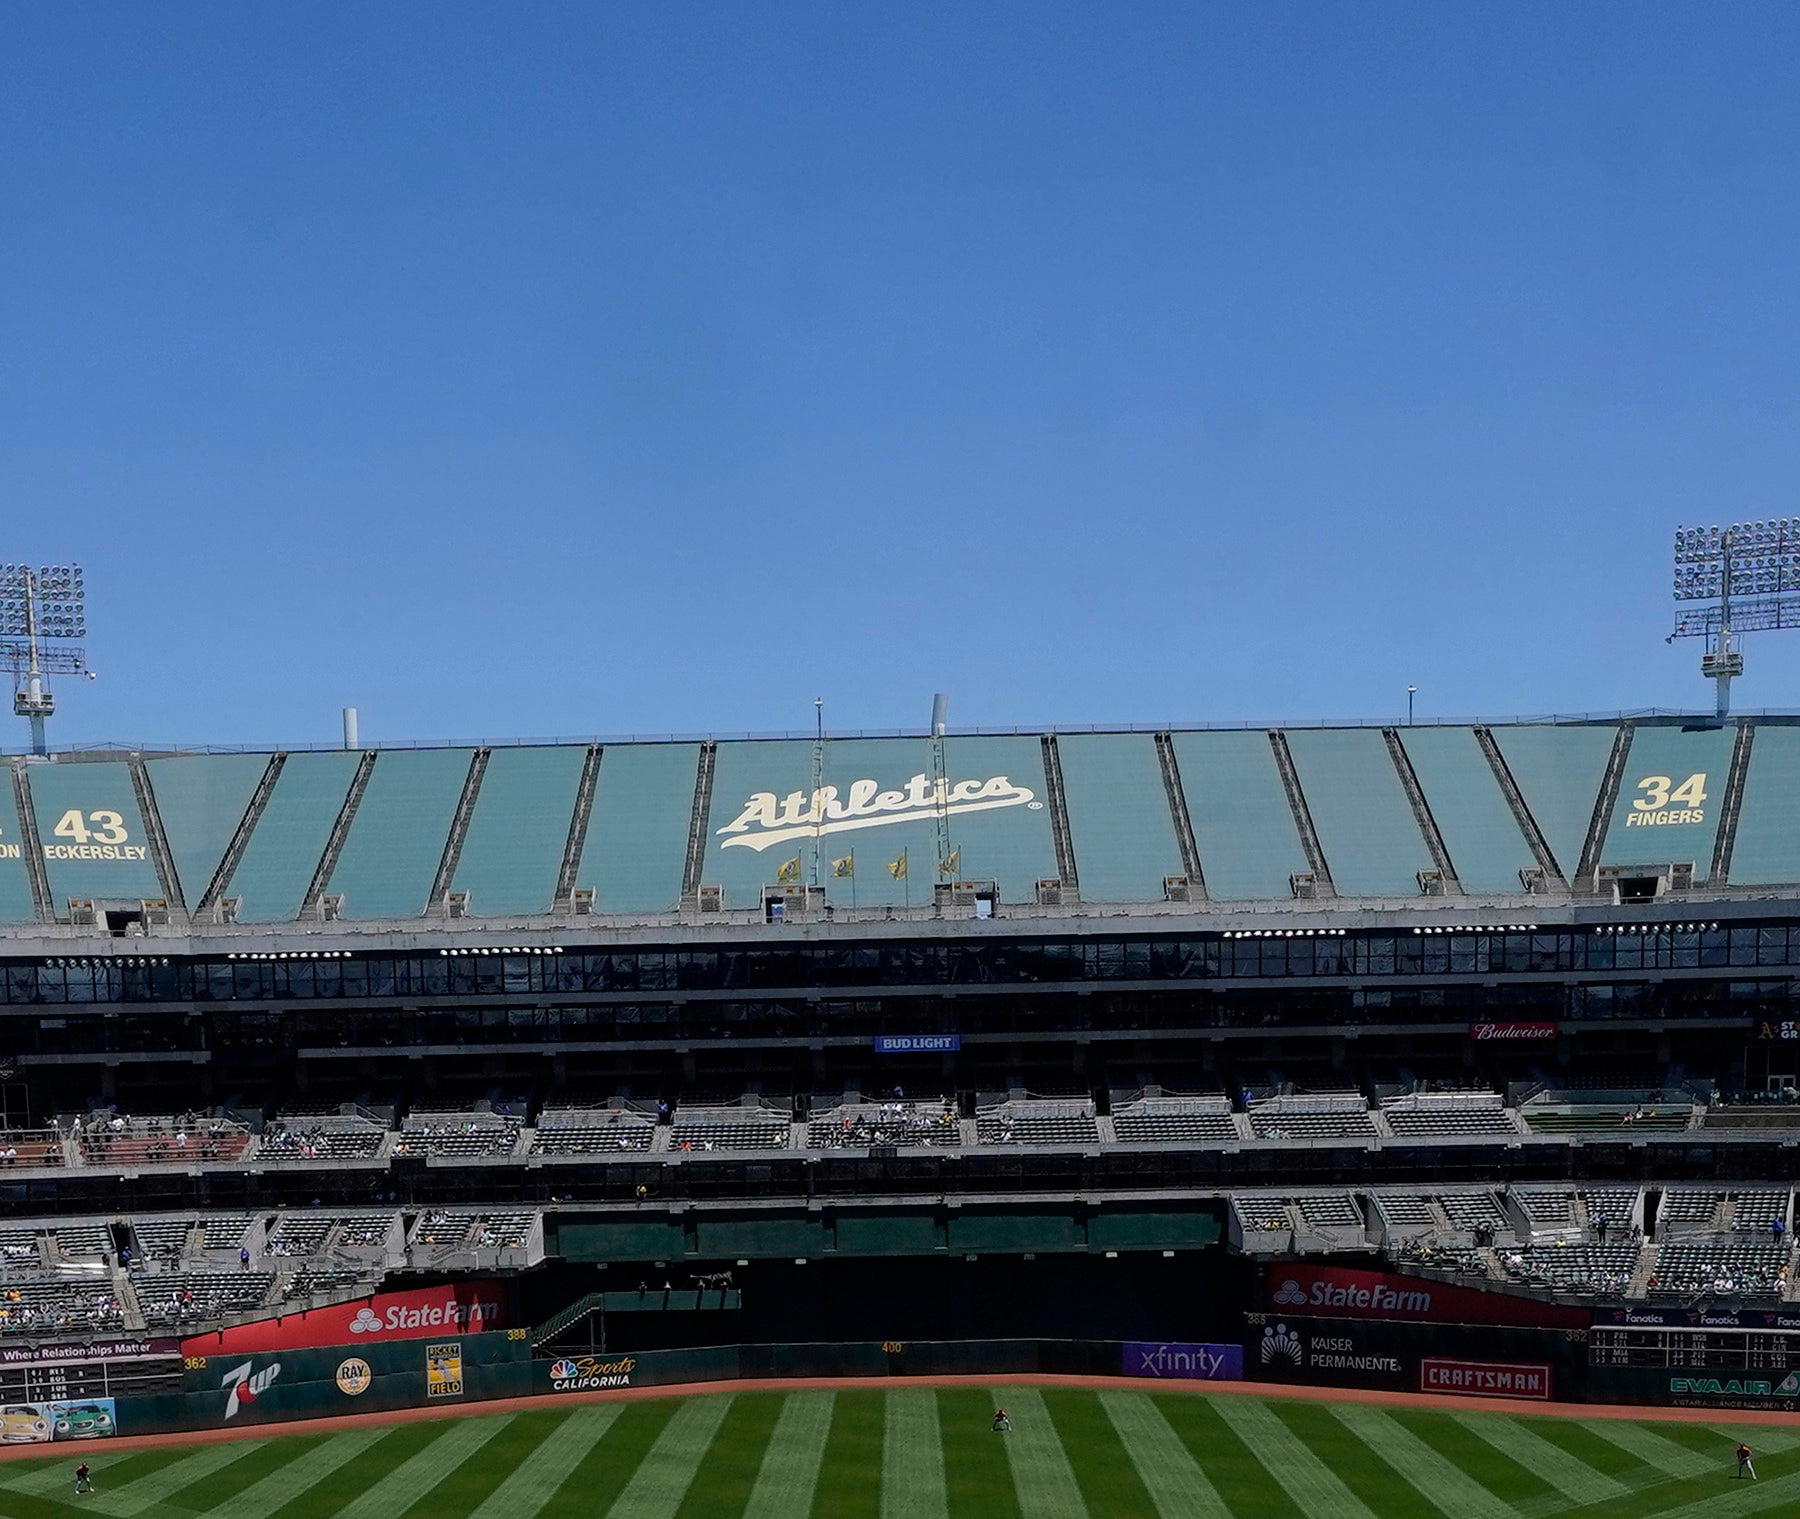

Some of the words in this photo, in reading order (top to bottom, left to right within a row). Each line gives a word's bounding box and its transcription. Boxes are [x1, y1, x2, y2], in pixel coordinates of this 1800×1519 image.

[1633, 772, 1707, 812] 34
[716, 772, 1035, 848] Athletics
[1626, 808, 1704, 828] FINGERS
[53, 809, 130, 845] 43
[44, 844, 147, 862] ECKERSLEY
[1474, 1023, 1555, 1041] Budweiser
[883, 1038, 911, 1049] BUD
[913, 1037, 952, 1048] LIGHT
[1625, 1313, 1664, 1325] Fanatics
[1701, 1315, 1740, 1326] Fanatics
[507, 1329, 527, 1341] 388
[1565, 1331, 1588, 1343] 362
[428, 1346, 458, 1356] RICKEY
[882, 1342, 902, 1354] 400
[1311, 1336, 1353, 1351] KAISER
[3, 1349, 40, 1362] Where
[42, 1345, 113, 1361] Relationships
[115, 1342, 151, 1354] Matter
[184, 1357, 206, 1370] 362
[576, 1357, 636, 1377] Sports
[1140, 1346, 1224, 1377] xfinity
[341, 1365, 365, 1380] RAY
[430, 1381, 460, 1395] FIELD
[553, 1374, 630, 1391] CALIFORNIA
